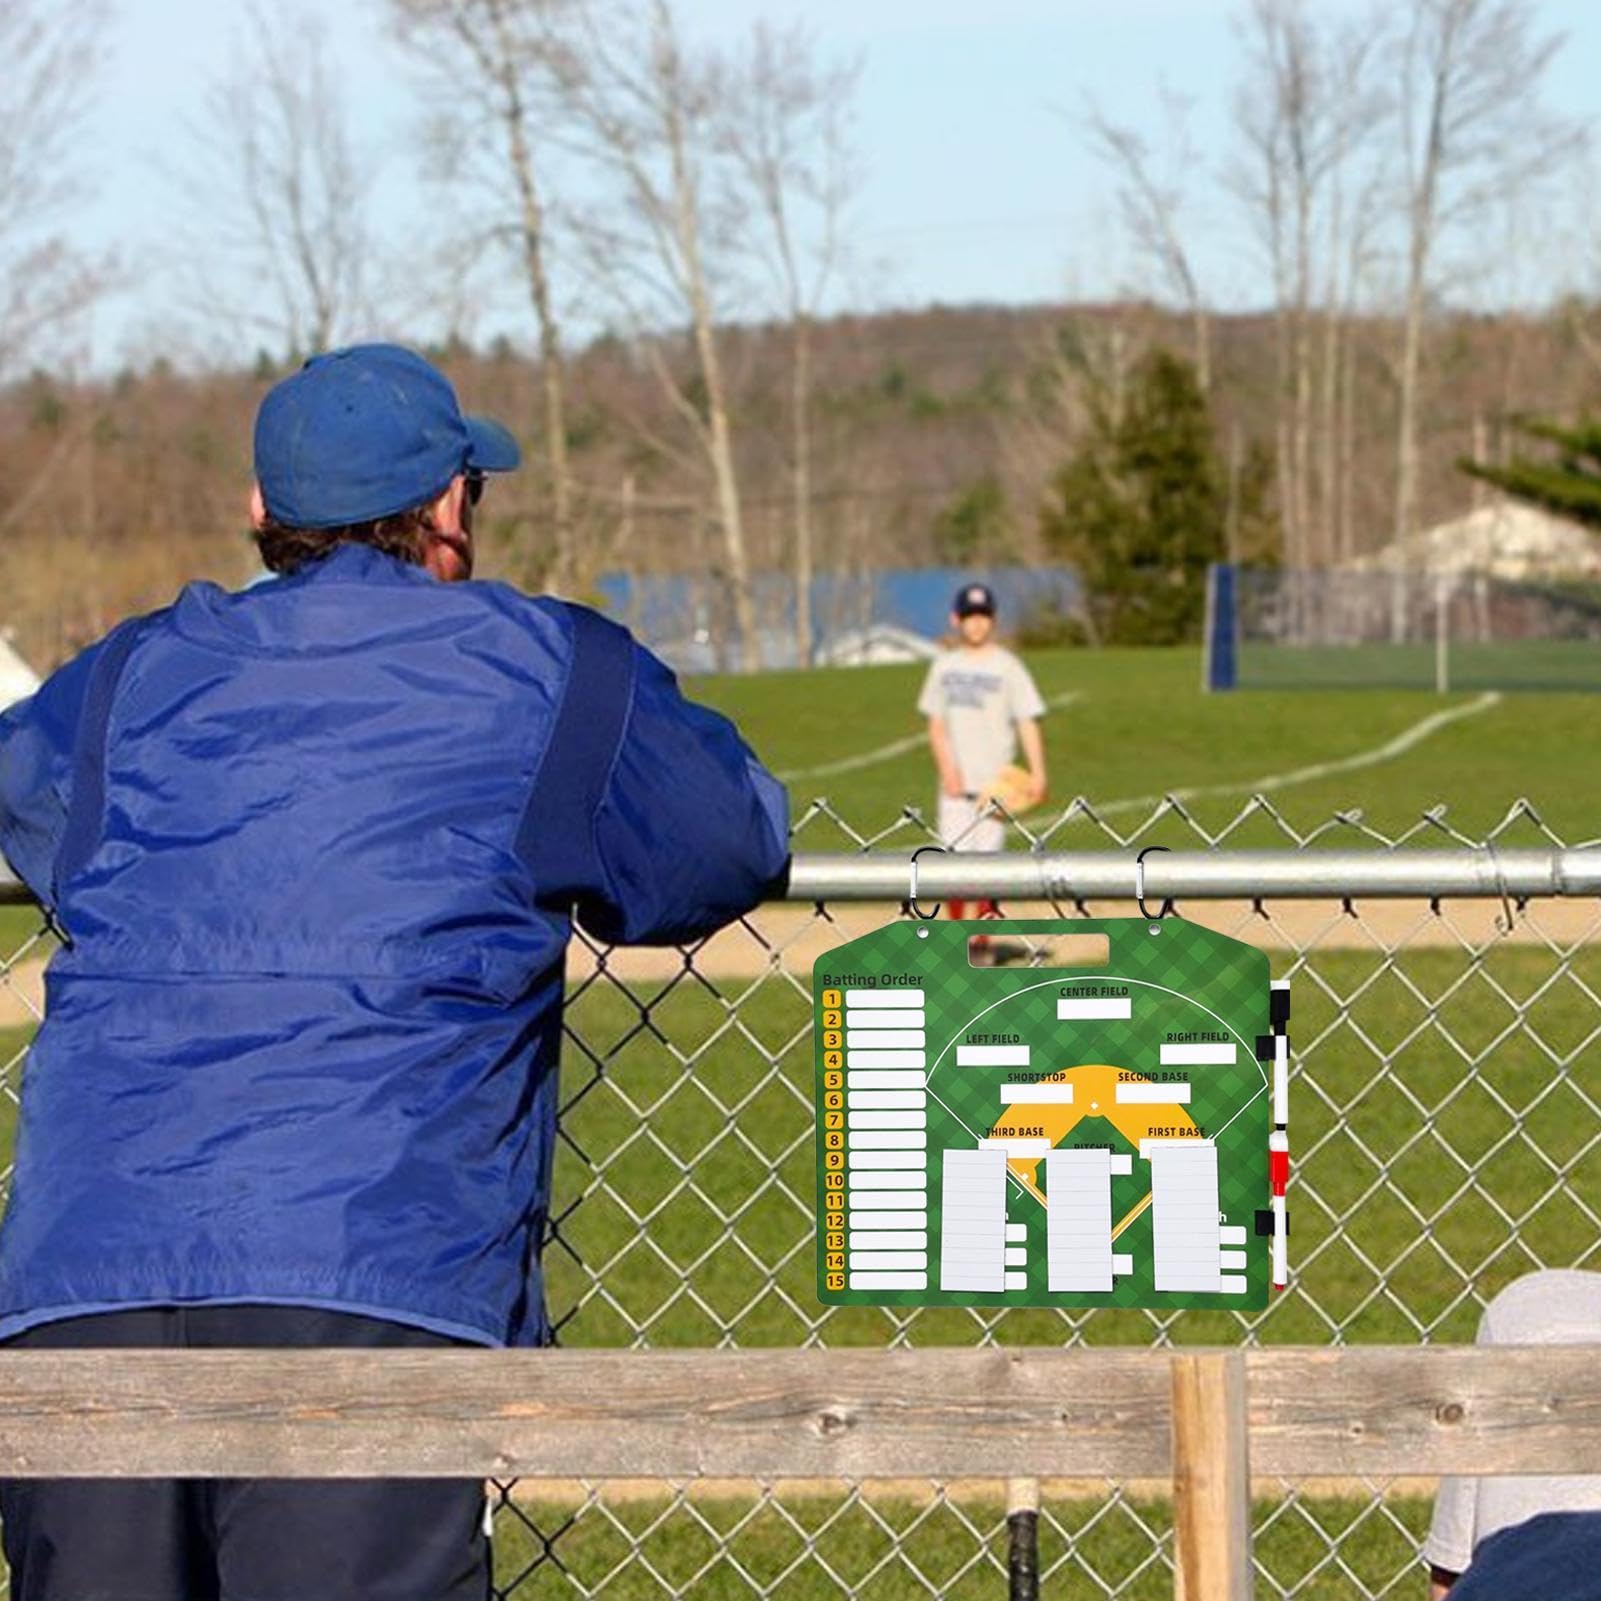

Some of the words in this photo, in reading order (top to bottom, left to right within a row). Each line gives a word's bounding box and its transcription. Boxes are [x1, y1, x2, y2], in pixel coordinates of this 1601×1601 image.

[823, 974, 876, 988] Batting
[881, 974, 924, 986] Order
[1060, 986, 1097, 997] CENTER
[1100, 986, 1129, 996] FIELD
[828, 994, 836, 1004] 1
[828, 1014, 837, 1025] 2
[829, 1034, 837, 1045] 3
[966, 1034, 989, 1044] LEFT
[992, 1033, 1020, 1044] FIELD
[1167, 1032, 1198, 1042] RIGHT
[1201, 1031, 1230, 1042] FIELD
[829, 1055, 838, 1065] 4
[830, 1074, 838, 1085] 5
[1007, 1072, 1066, 1082] SHORTSTOP
[1118, 1072, 1159, 1081] SECOND
[1162, 1072, 1188, 1081] BASE
[830, 1095, 838, 1106] 6
[830, 1115, 838, 1126] 7
[986, 1127, 1016, 1137] THIRD
[1019, 1127, 1044, 1137] BASE
[1148, 1127, 1176, 1137] FIRST
[1178, 1127, 1205, 1137] BASE
[831, 1135, 839, 1146] 8
[831, 1155, 839, 1166] 9
[827, 1175, 843, 1186] 10
[827, 1195, 843, 1206] 11
[827, 1215, 843, 1226] 12
[827, 1235, 844, 1246] 13
[828, 1255, 844, 1266] 14
[828, 1275, 844, 1286] 15
